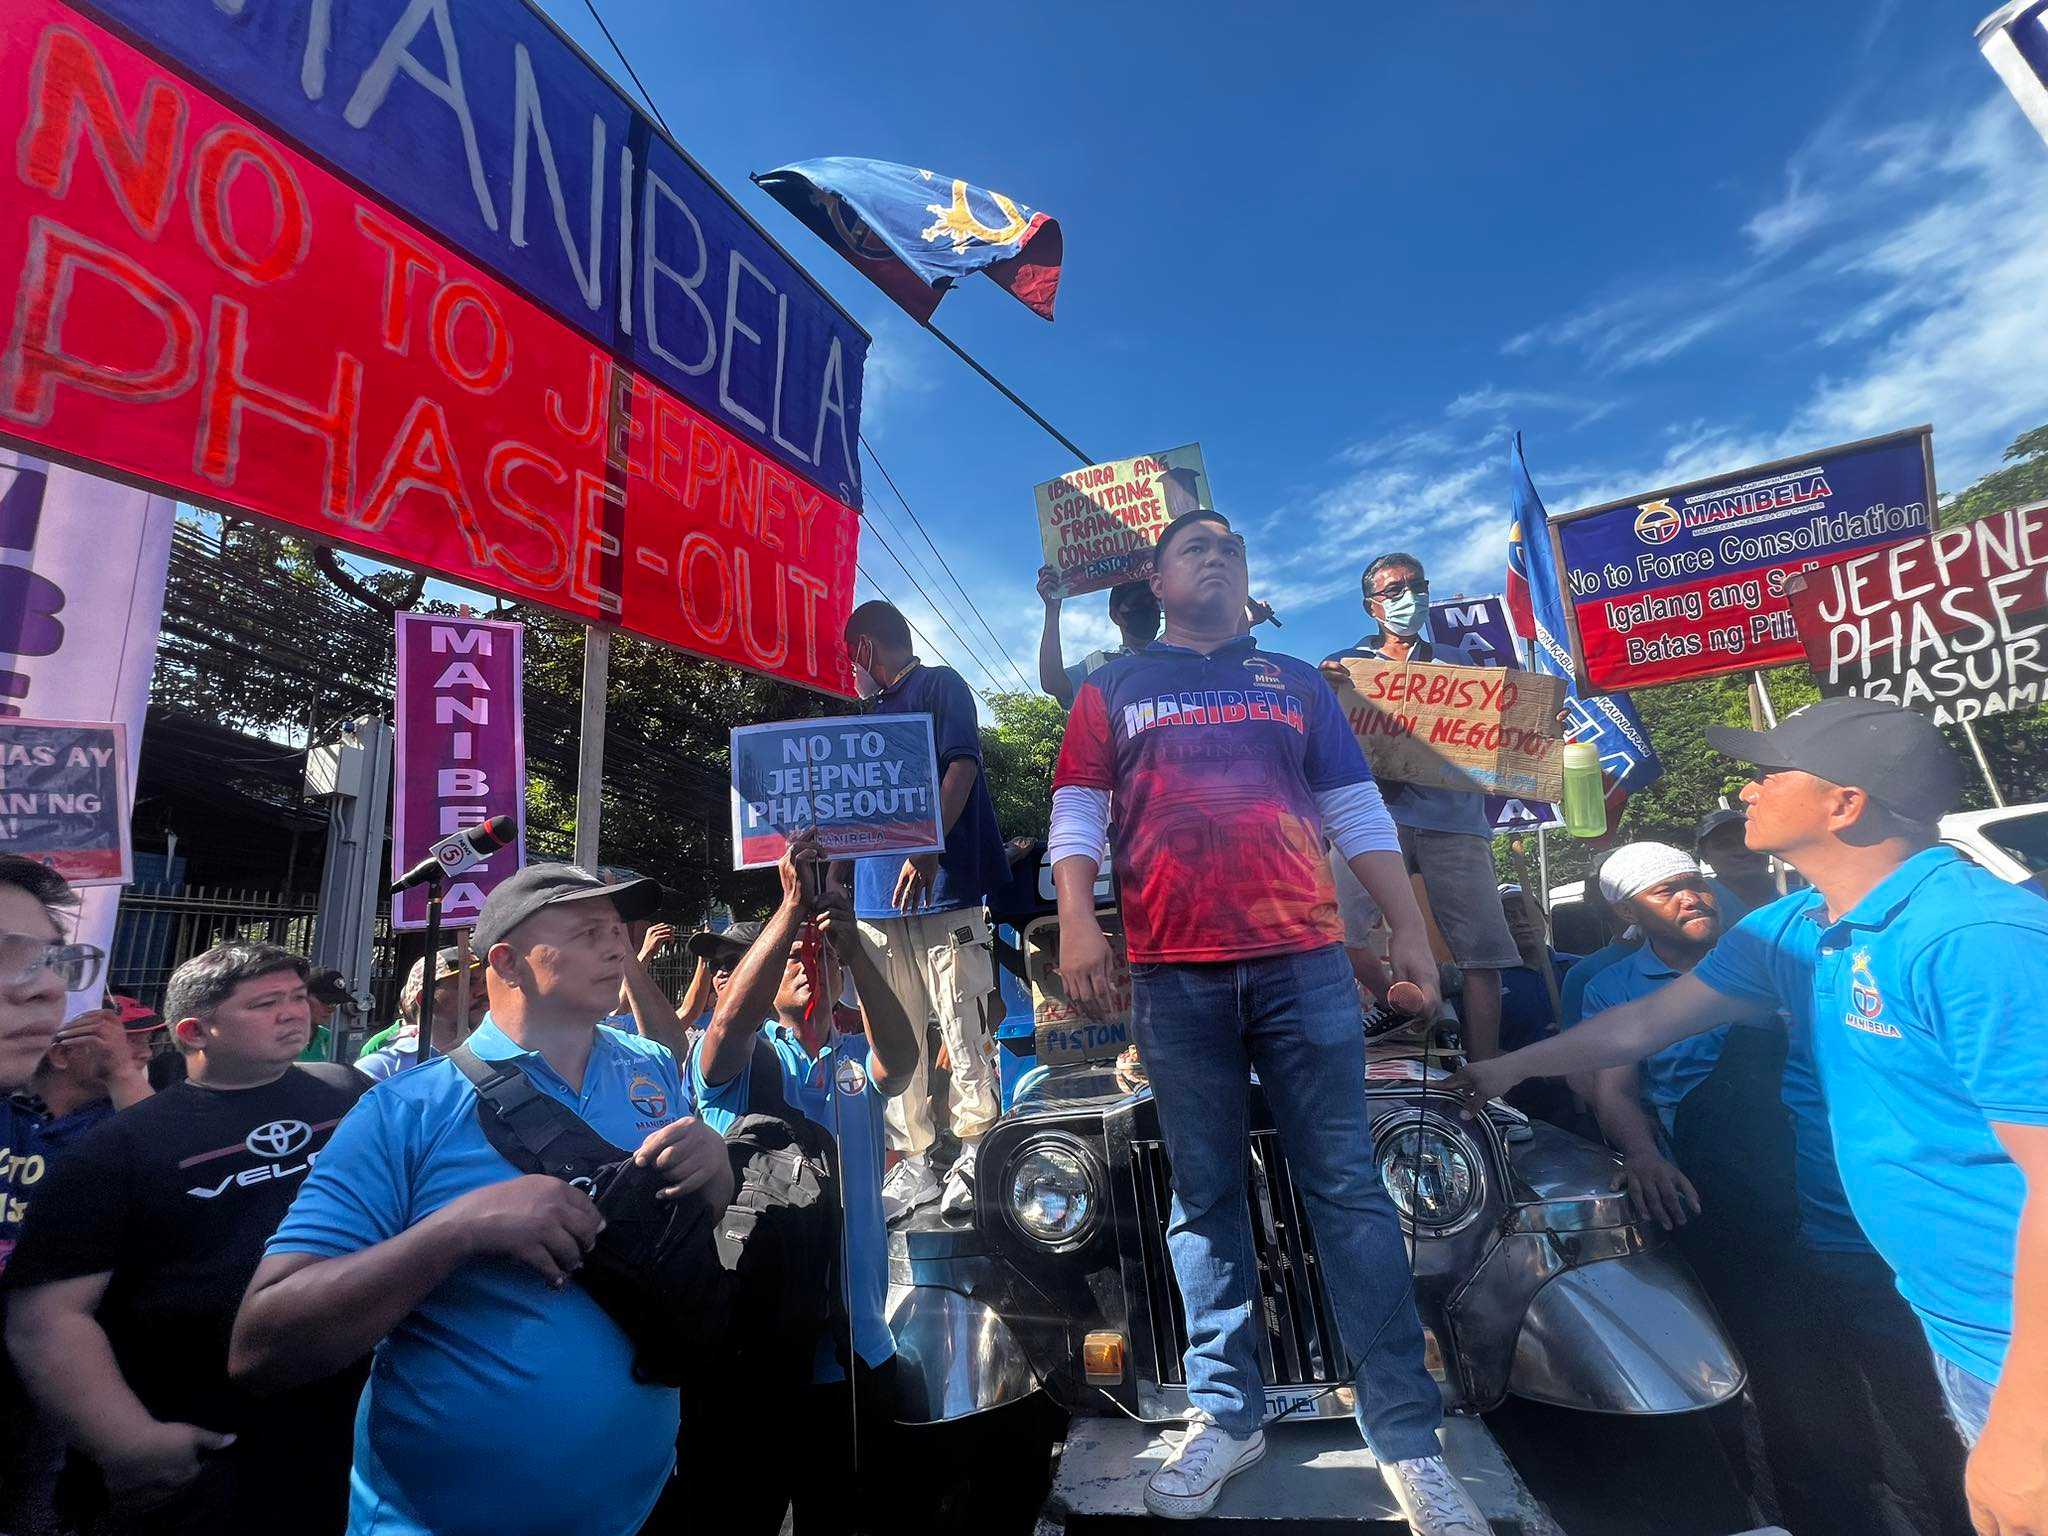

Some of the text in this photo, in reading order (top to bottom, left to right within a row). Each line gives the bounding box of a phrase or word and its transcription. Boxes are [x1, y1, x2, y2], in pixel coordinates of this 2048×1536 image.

[212, 0, 862, 488] ANIBELA
[15, 24, 824, 560] NO TO JEEPNEY
[0, 217, 827, 678] PHASE-OUT
[1133, 455, 1169, 478] ANG
[1060, 498, 1162, 545] FRANCHISE
[1682, 476, 1833, 528] MANIBELA
[1568, 568, 1601, 597] No
[1603, 562, 1632, 590] to
[1637, 545, 1714, 584] Force
[1605, 590, 1703, 632] Igalang
[1708, 578, 1761, 611] ang
[1829, 568, 2048, 685] PHASE
[1627, 608, 1802, 666] Batas ng Pili
[1122, 690, 1304, 740] MANIBELA
[1366, 671, 1519, 712] SERBISYO
[1349, 706, 1418, 739] HINDI
[1599, 697, 1652, 759] KAUNLARAN
[65, 746, 114, 768] AY
[782, 731, 886, 764] NO TO
[766, 760, 904, 796] JEEPNEY
[48, 792, 102, 814] NG
[748, 786, 928, 828] PHASEOUT!
[1046, 1022, 1127, 1056] PISTON
[186, 1151, 320, 1198] VEL
